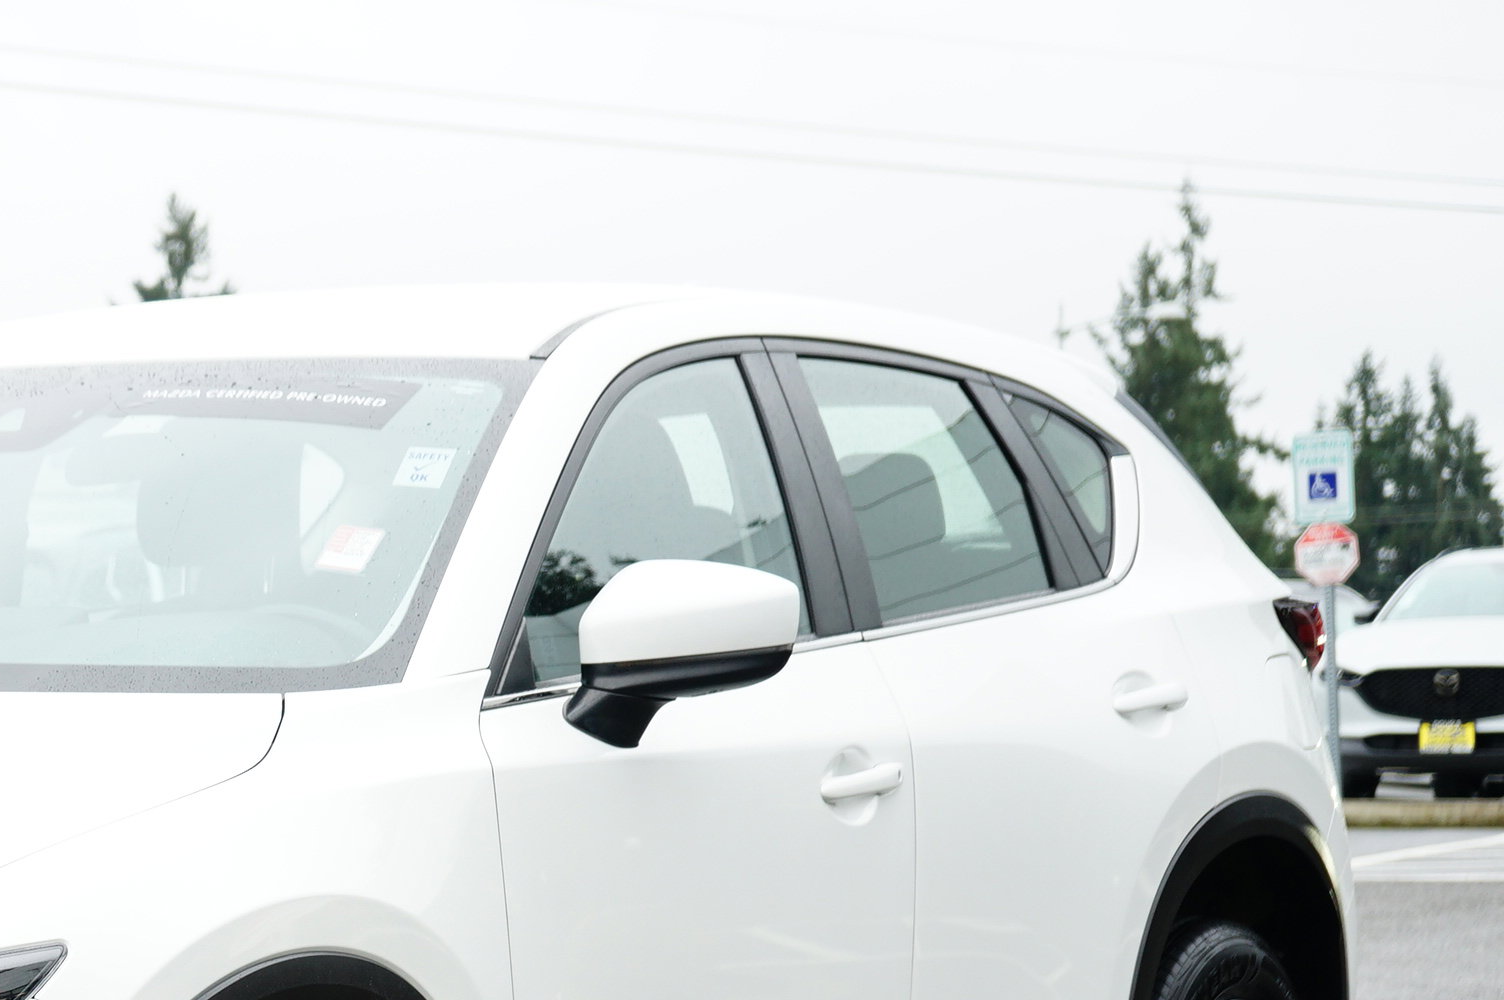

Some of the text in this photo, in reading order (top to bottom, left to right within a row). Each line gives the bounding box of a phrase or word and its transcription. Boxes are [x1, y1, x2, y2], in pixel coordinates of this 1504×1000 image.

[142, 388, 387, 408] MAZDA CERTIFIED PRE-OWNED
[410, 473, 429, 482] OK
